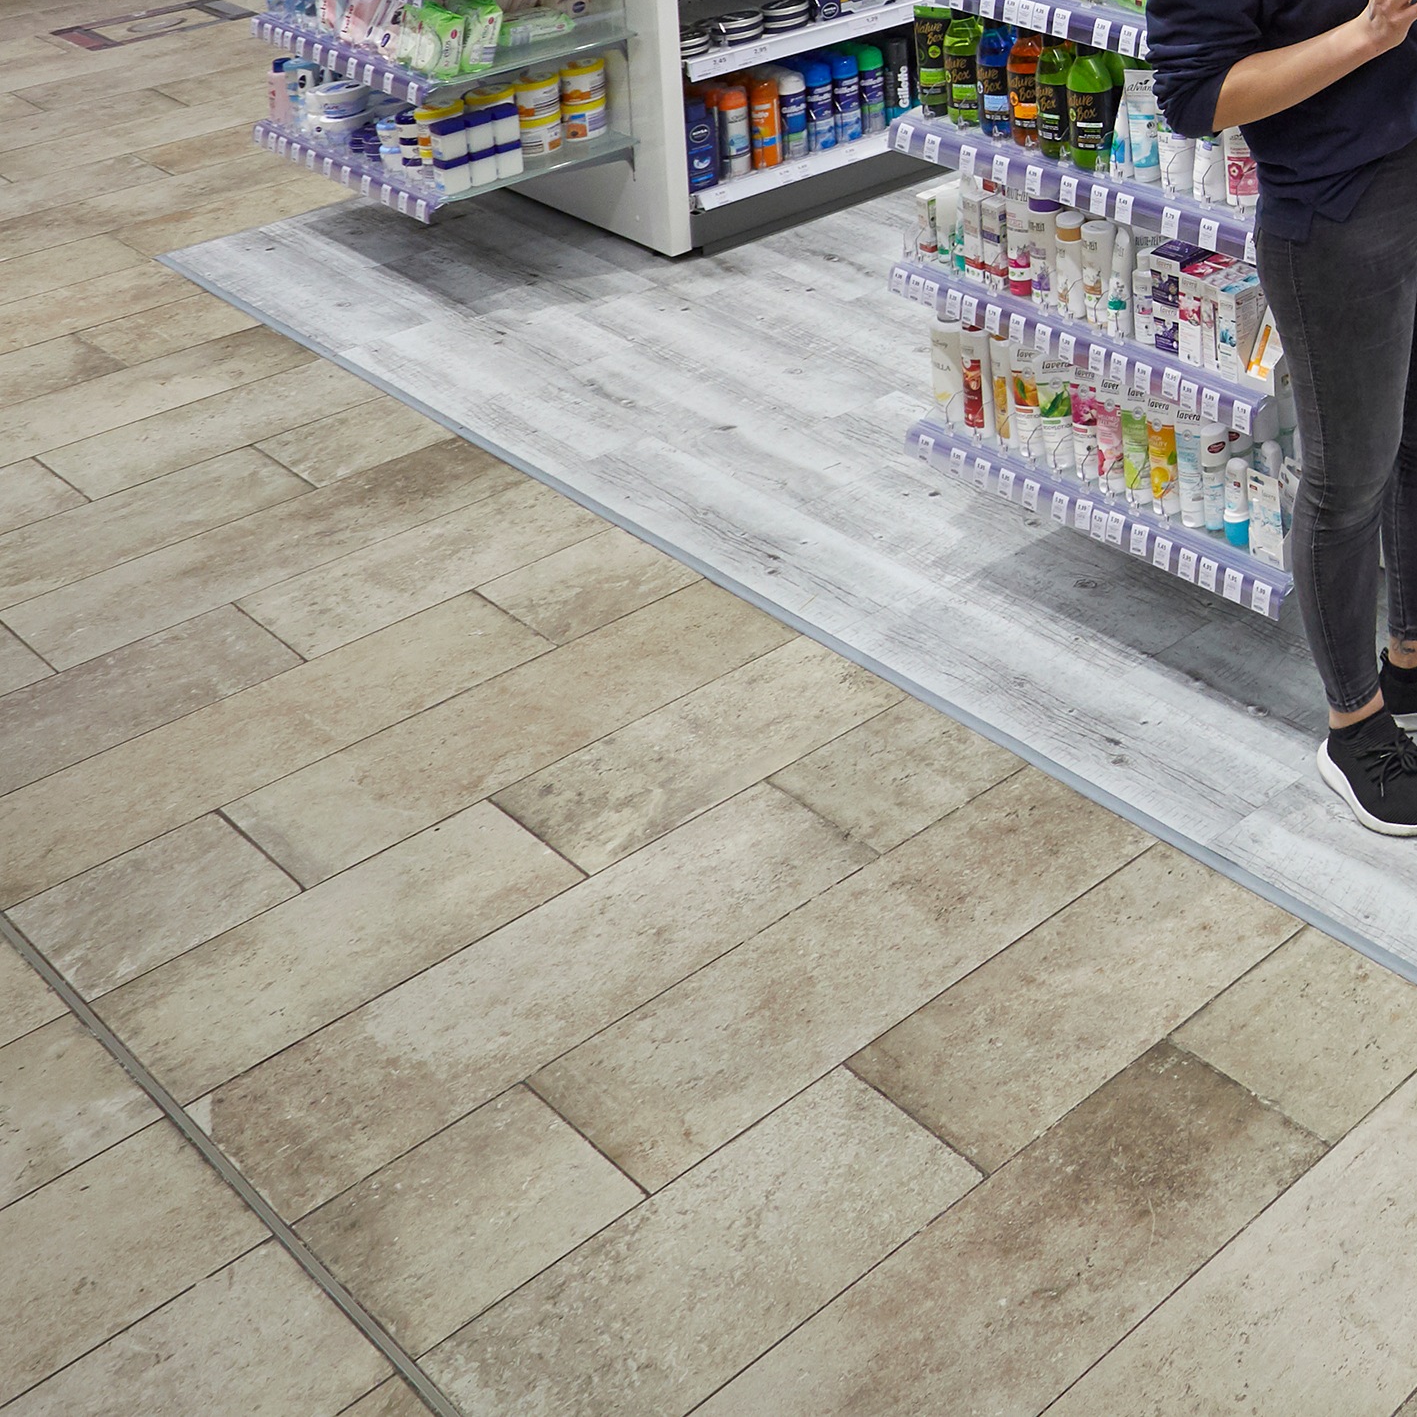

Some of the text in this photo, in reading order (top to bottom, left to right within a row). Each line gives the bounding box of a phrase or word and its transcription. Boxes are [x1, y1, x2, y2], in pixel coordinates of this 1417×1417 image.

[897, 65, 908, 109] Gillette
[1075, 368, 1095, 379] lavera
[1176, 410, 1200, 421] lavera
